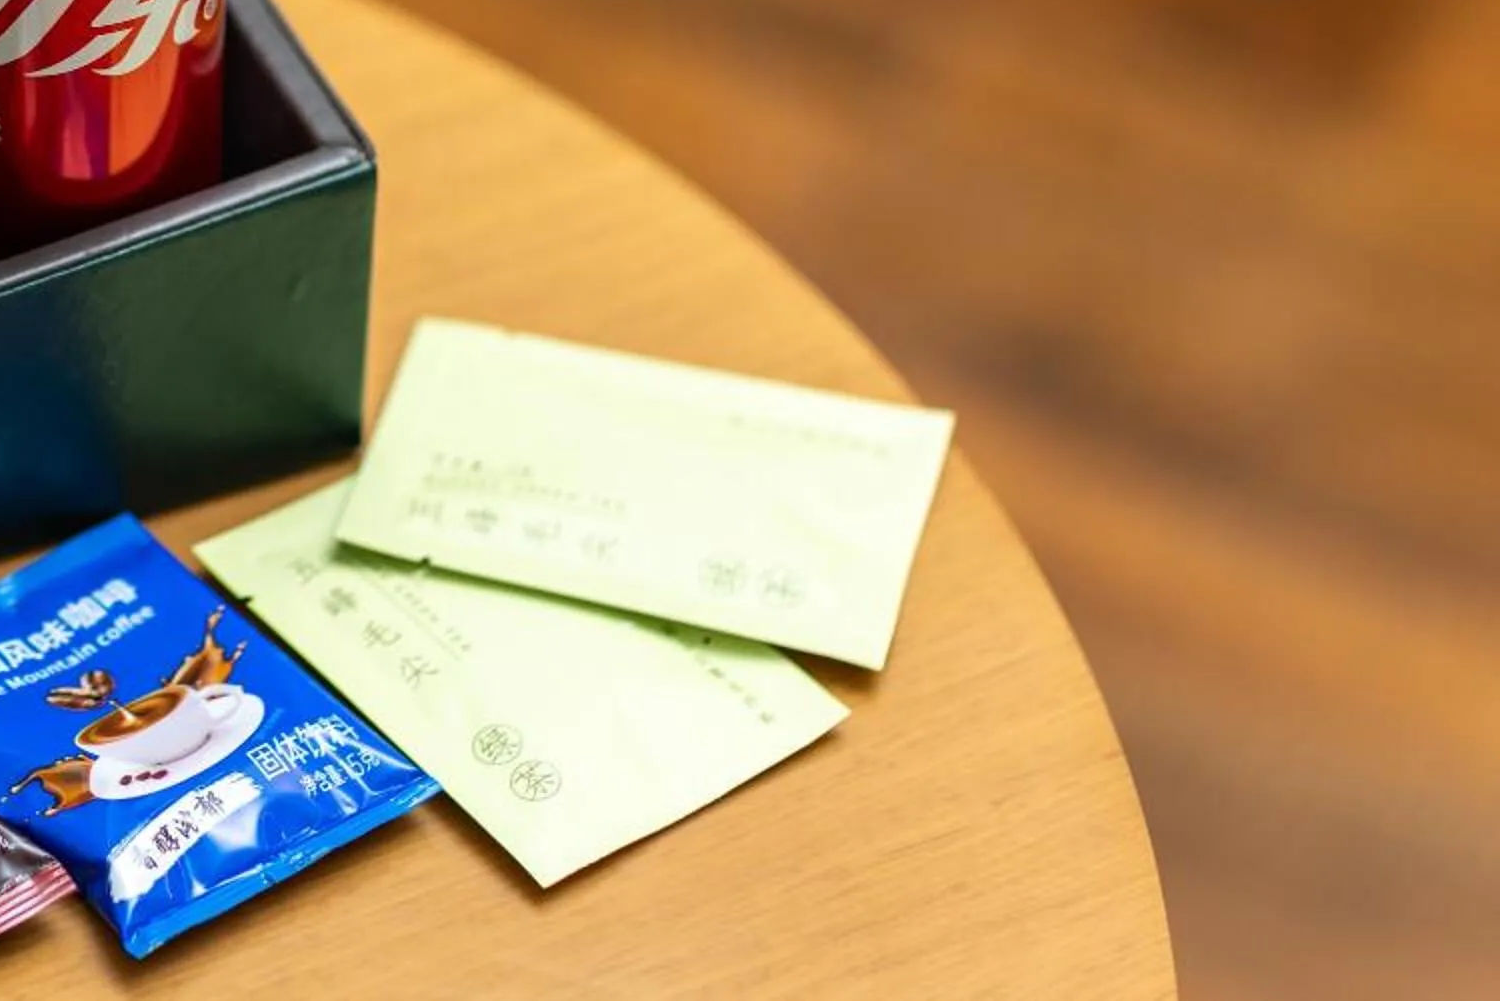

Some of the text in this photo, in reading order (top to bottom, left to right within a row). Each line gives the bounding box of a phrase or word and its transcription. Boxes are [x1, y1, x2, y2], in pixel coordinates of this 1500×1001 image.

[4, 643, 98, 689] Mountain
[97, 606, 156, 647] coffee
[246, 713, 360, 781] 固体饮料
